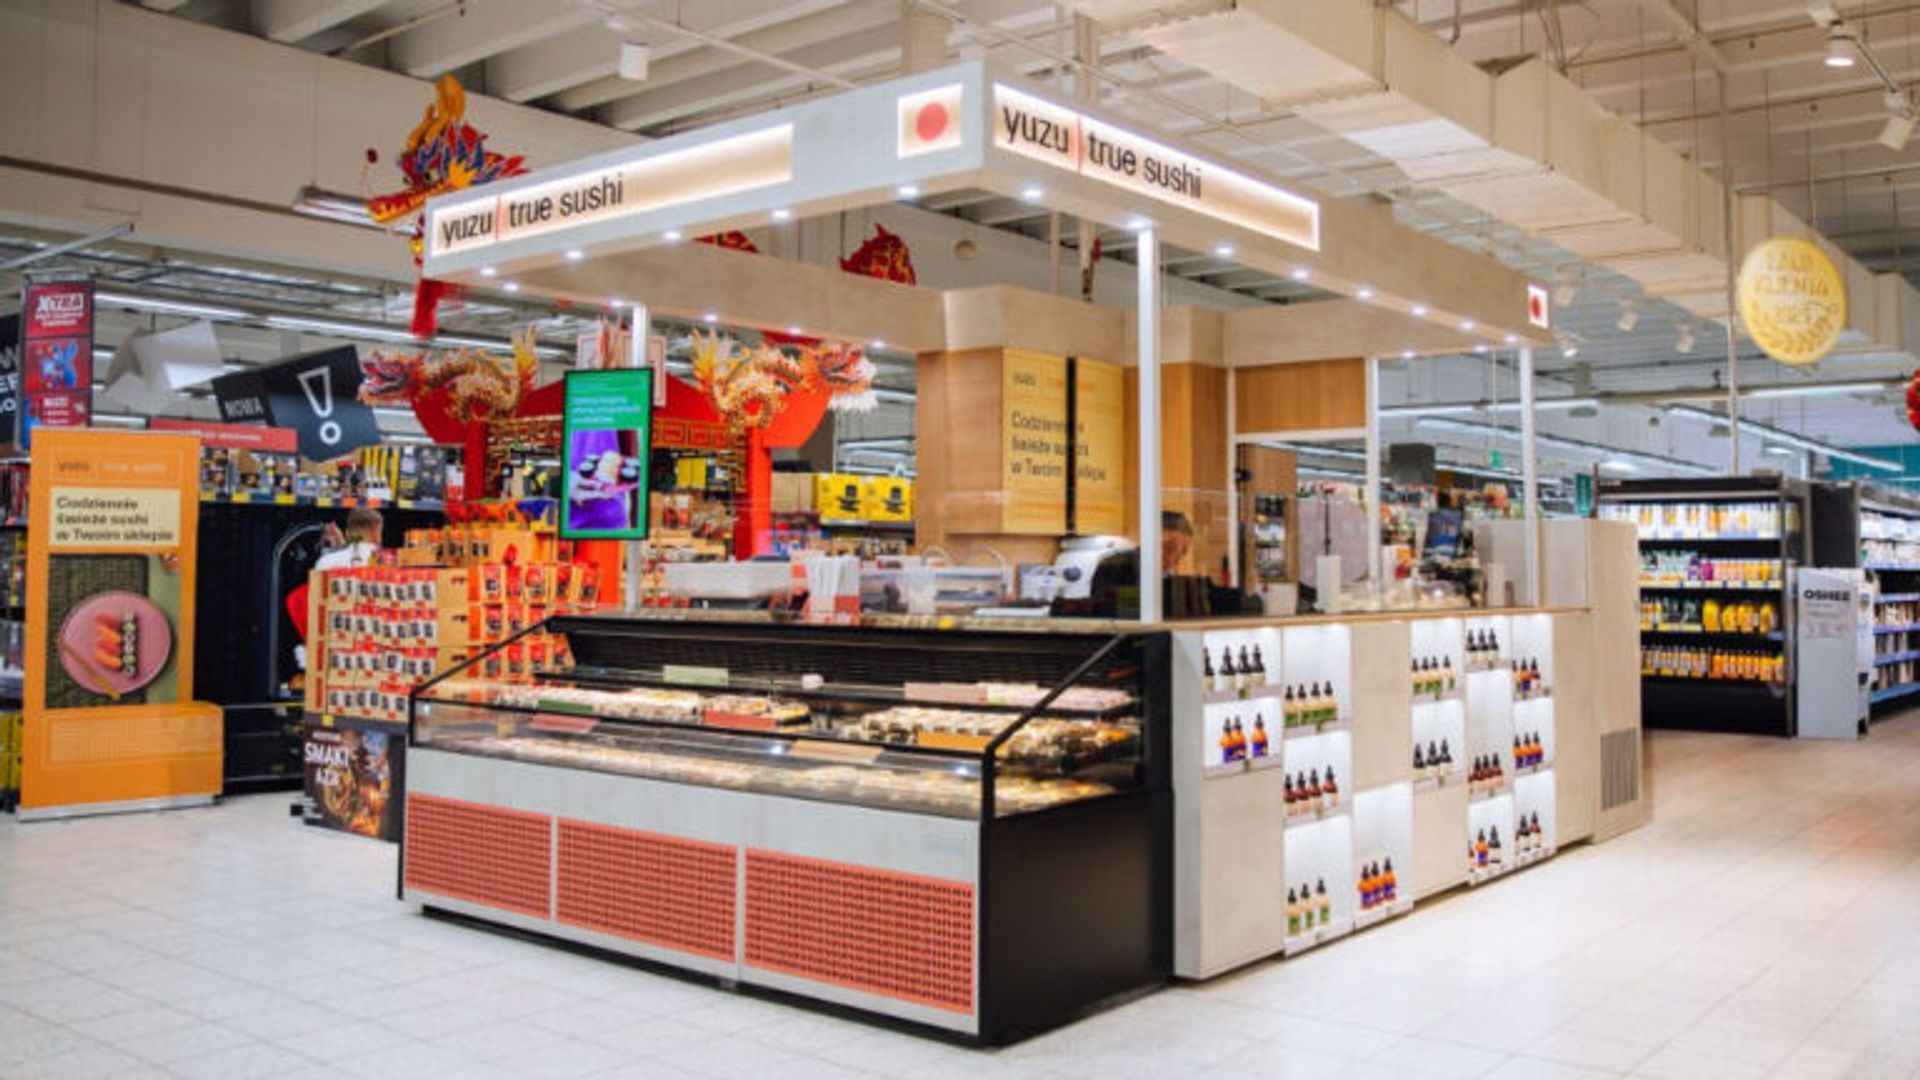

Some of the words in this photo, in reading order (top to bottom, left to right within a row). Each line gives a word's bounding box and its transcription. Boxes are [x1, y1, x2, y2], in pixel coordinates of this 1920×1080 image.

[1002, 105, 1070, 154] yuzu
[1088, 132, 1136, 176] true
[1143, 155, 1202, 199] sushi
[441, 210, 493, 248] yuzu
[508, 196, 552, 228] true
[559, 172, 624, 217] sushi
